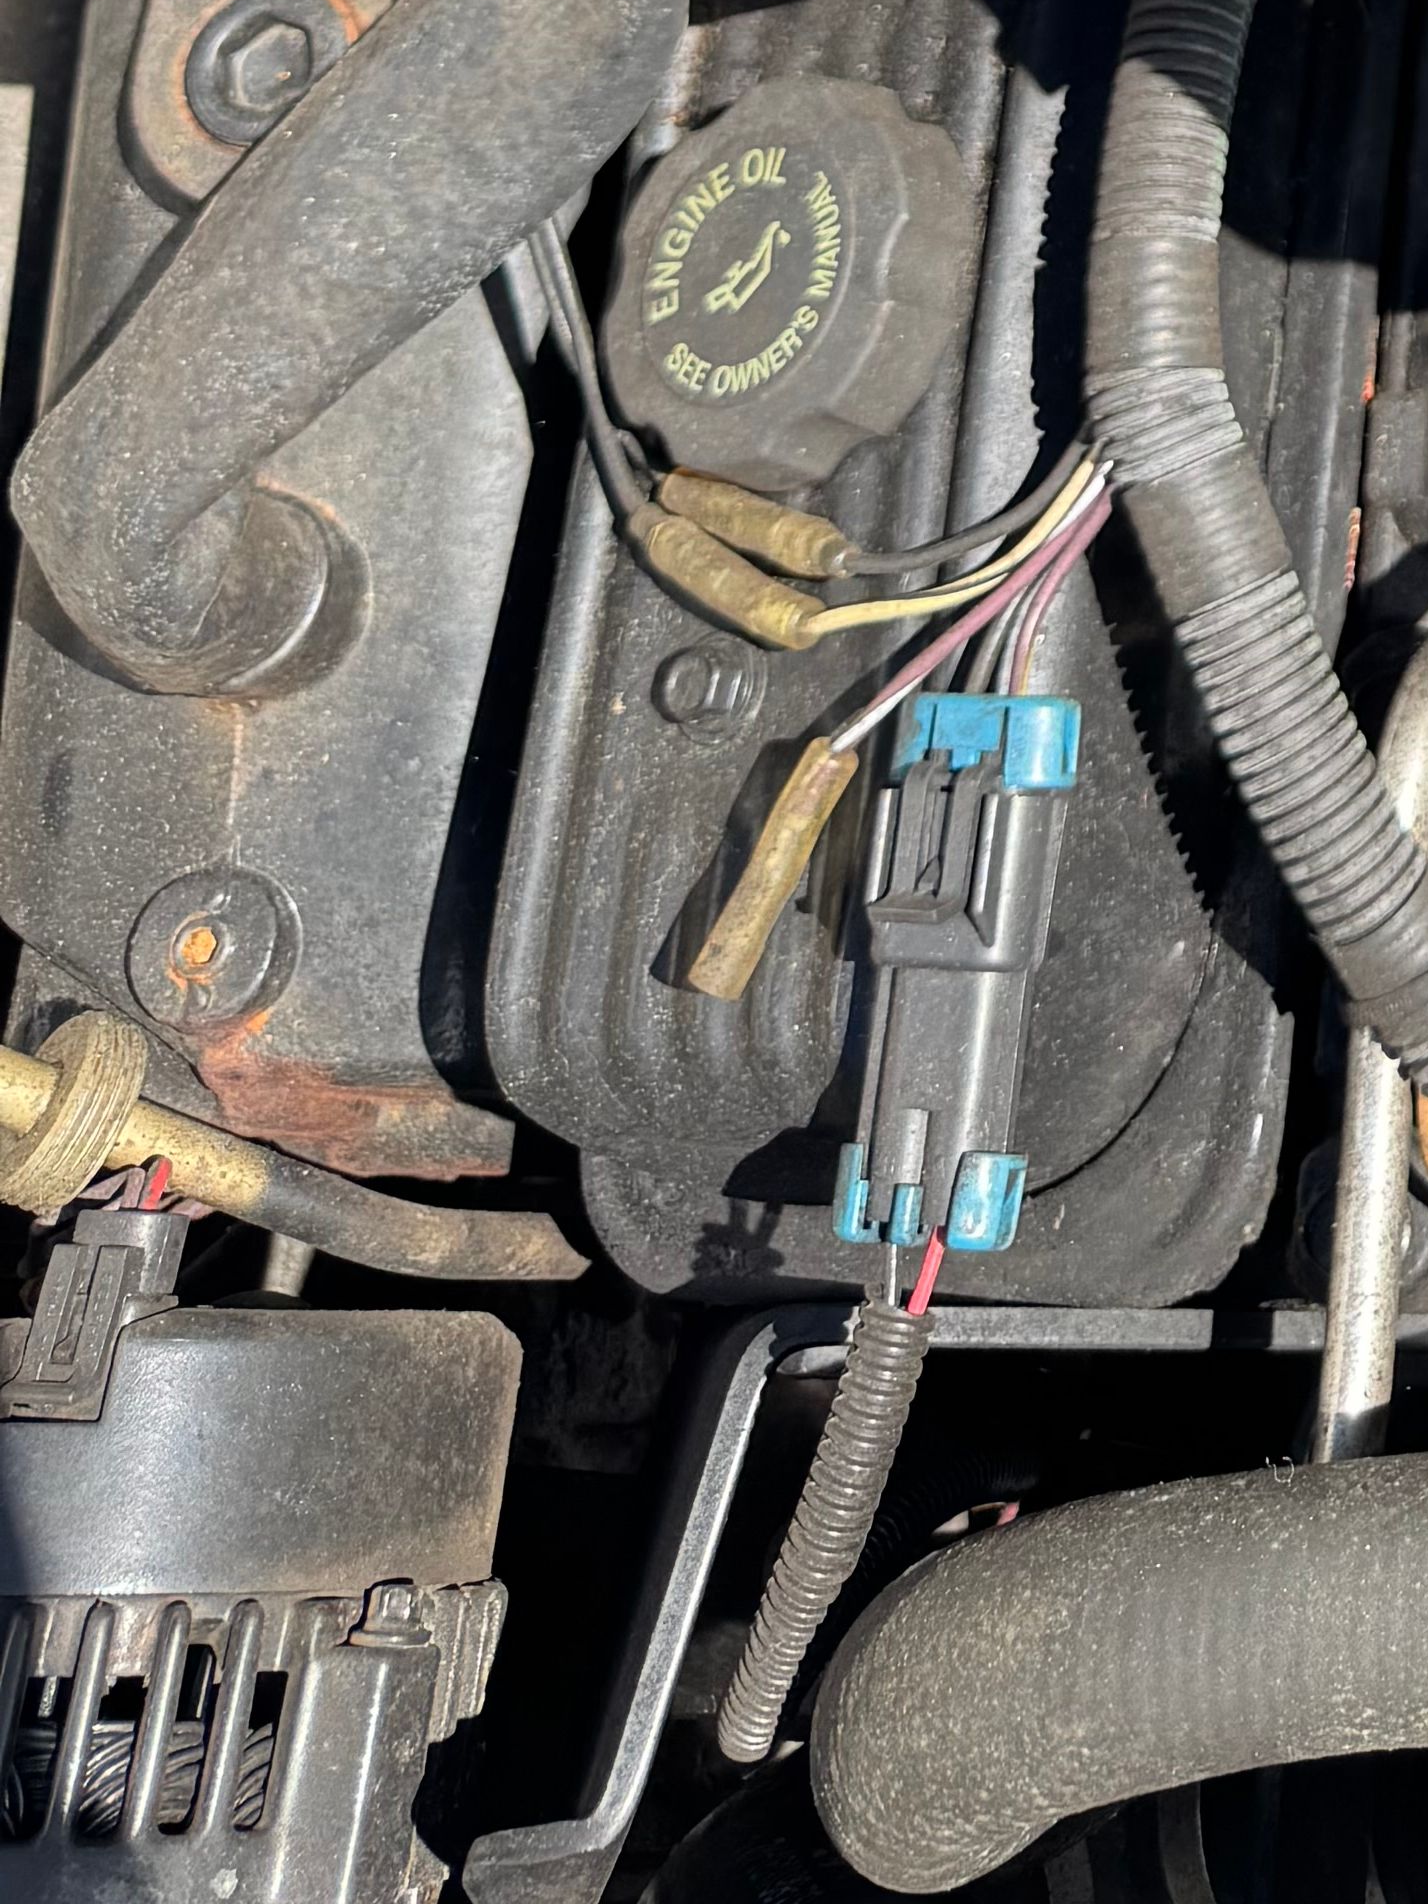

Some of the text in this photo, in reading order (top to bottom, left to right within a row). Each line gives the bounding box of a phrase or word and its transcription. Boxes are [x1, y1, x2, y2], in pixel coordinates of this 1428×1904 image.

[648, 146, 787, 326] ENGINE OIL
[663, 170, 842, 397] SEE OWNER'S MANUAL
